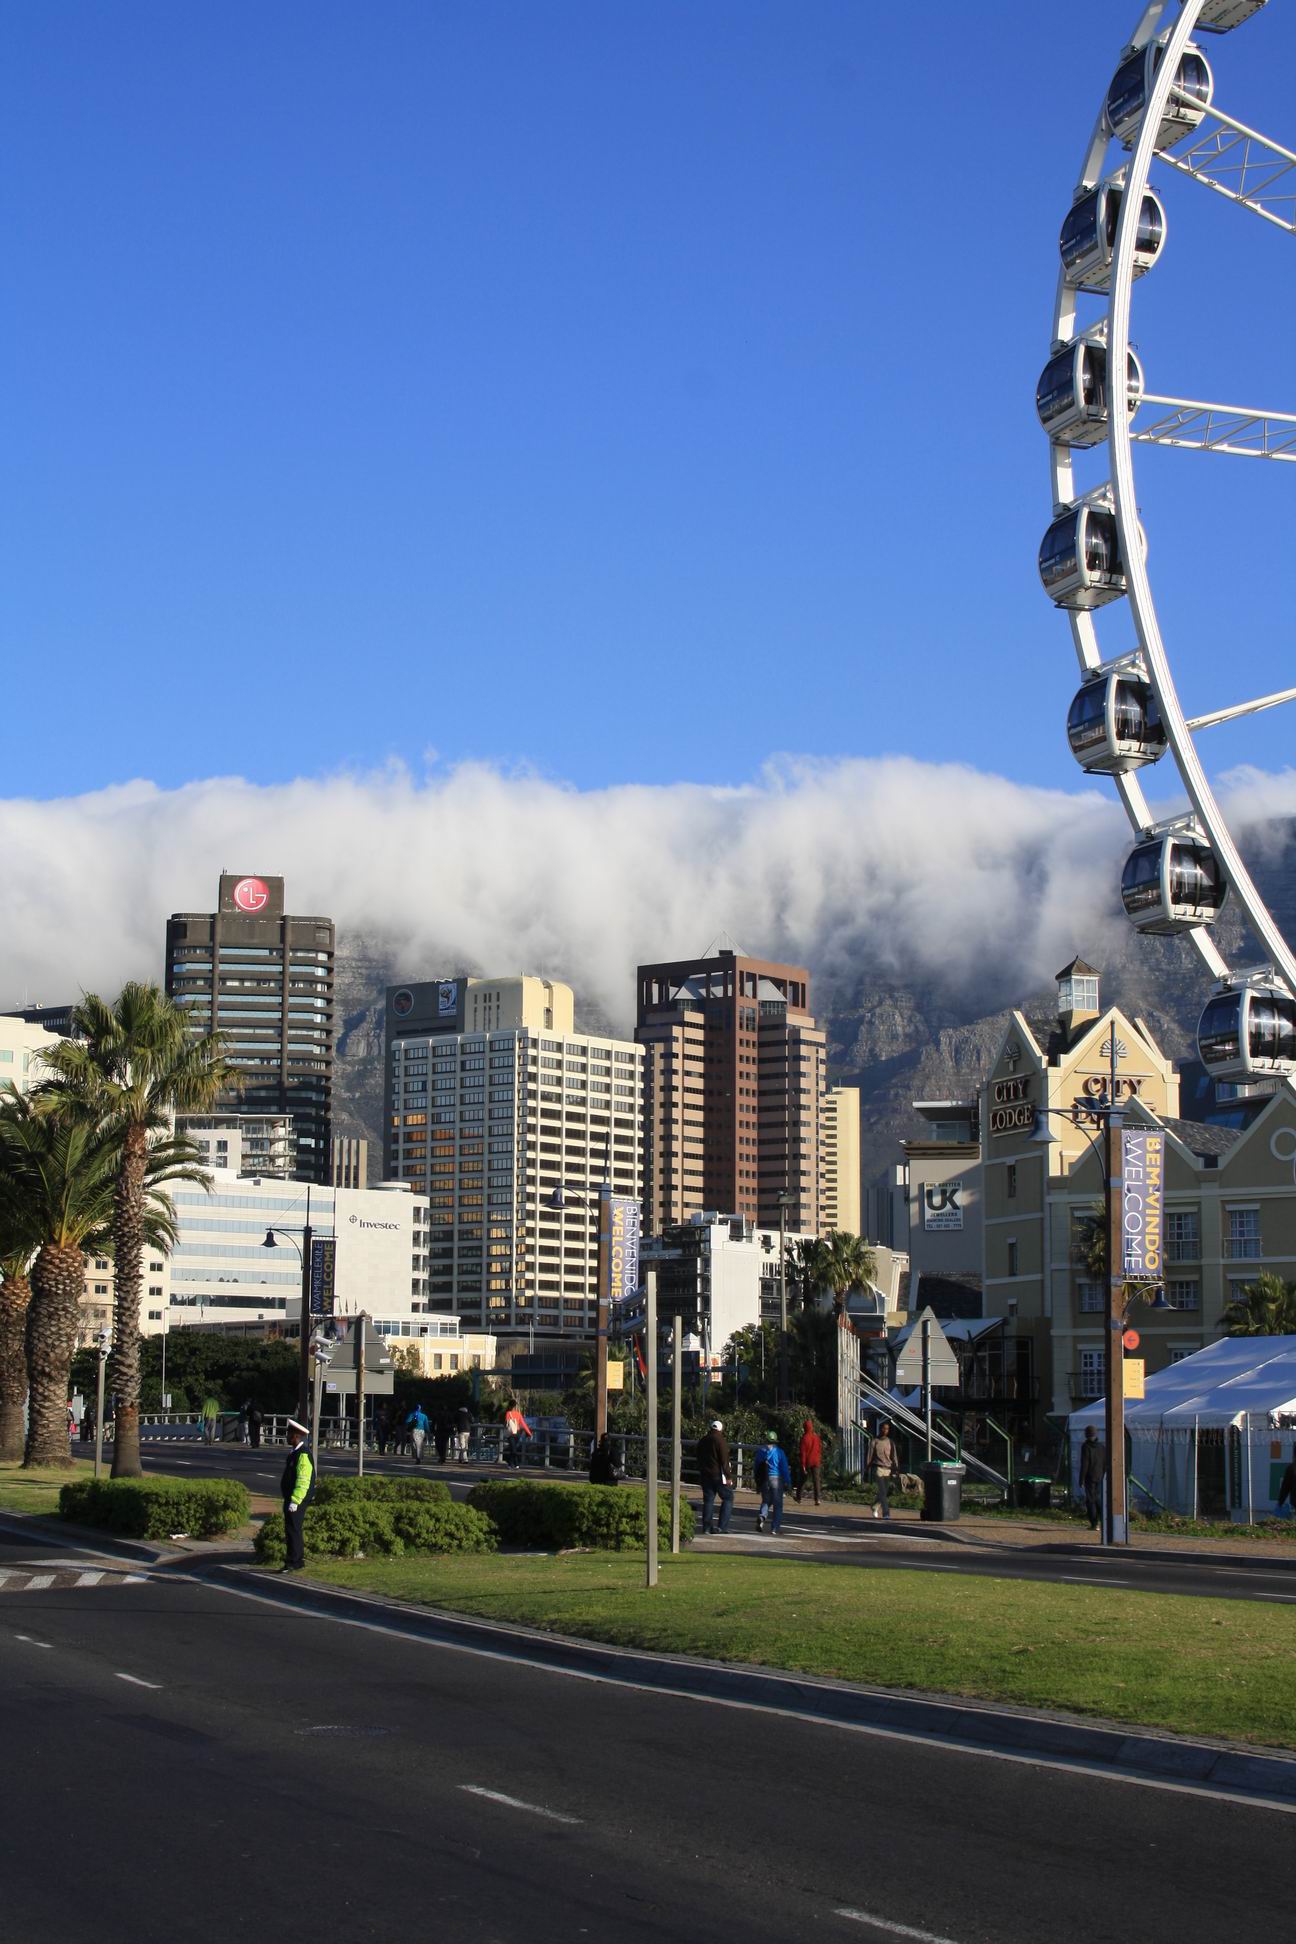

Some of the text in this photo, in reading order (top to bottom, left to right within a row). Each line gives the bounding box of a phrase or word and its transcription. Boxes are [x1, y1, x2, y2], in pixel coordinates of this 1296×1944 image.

[236, 880, 267, 910] LG
[994, 1078, 1027, 1103] CITY
[1083, 1075, 1145, 1097] CITY
[989, 1104, 1034, 1131] LODGE
[926, 1188, 960, 1211] UK
[1124, 1136, 1143, 1269] WELCOME
[1144, 1137, 1162, 1270] BEM-VINDO
[359, 1219, 401, 1230] Investec
[611, 1206, 624, 1298] WELCOME
[322, 1243, 334, 1311] WELCOME
